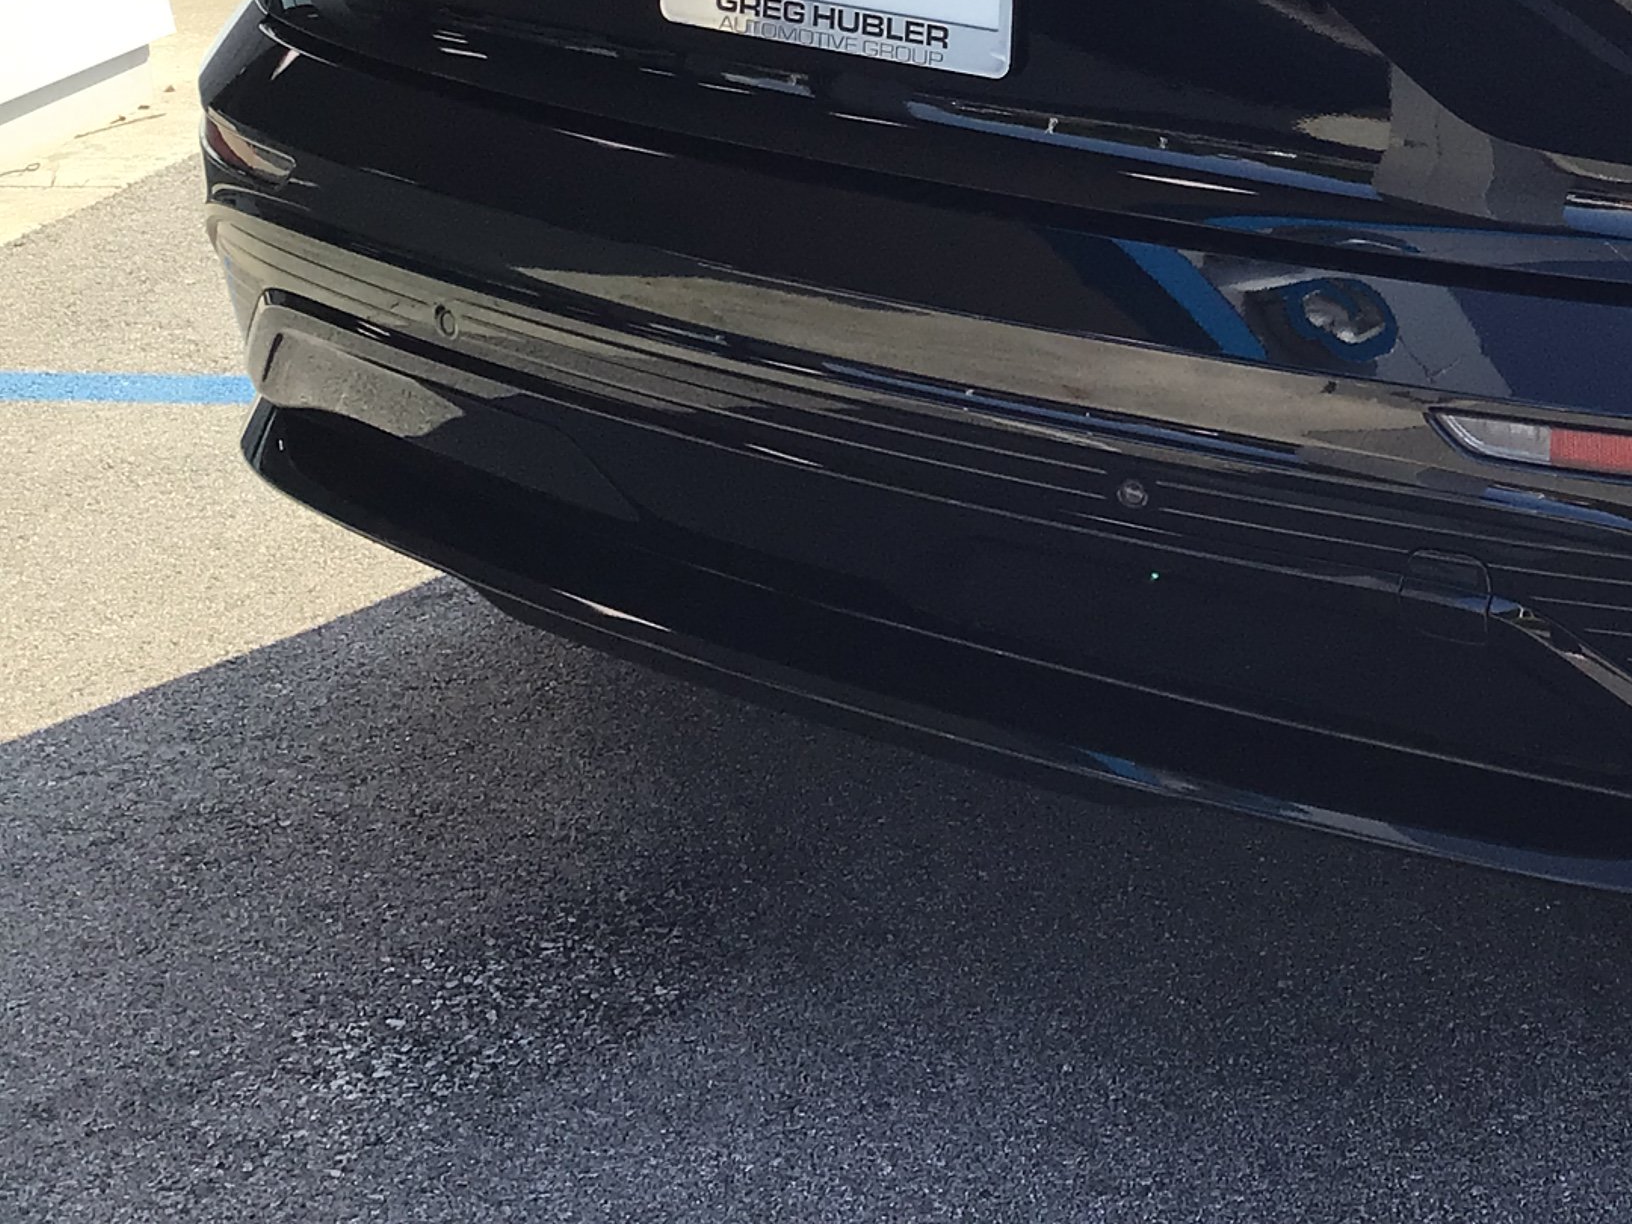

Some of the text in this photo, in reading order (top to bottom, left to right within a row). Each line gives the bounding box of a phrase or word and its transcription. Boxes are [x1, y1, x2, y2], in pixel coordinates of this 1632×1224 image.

[718, 15, 944, 67] AUTOMOTIVE GROUP
[813, 5, 949, 49] HUBLER
